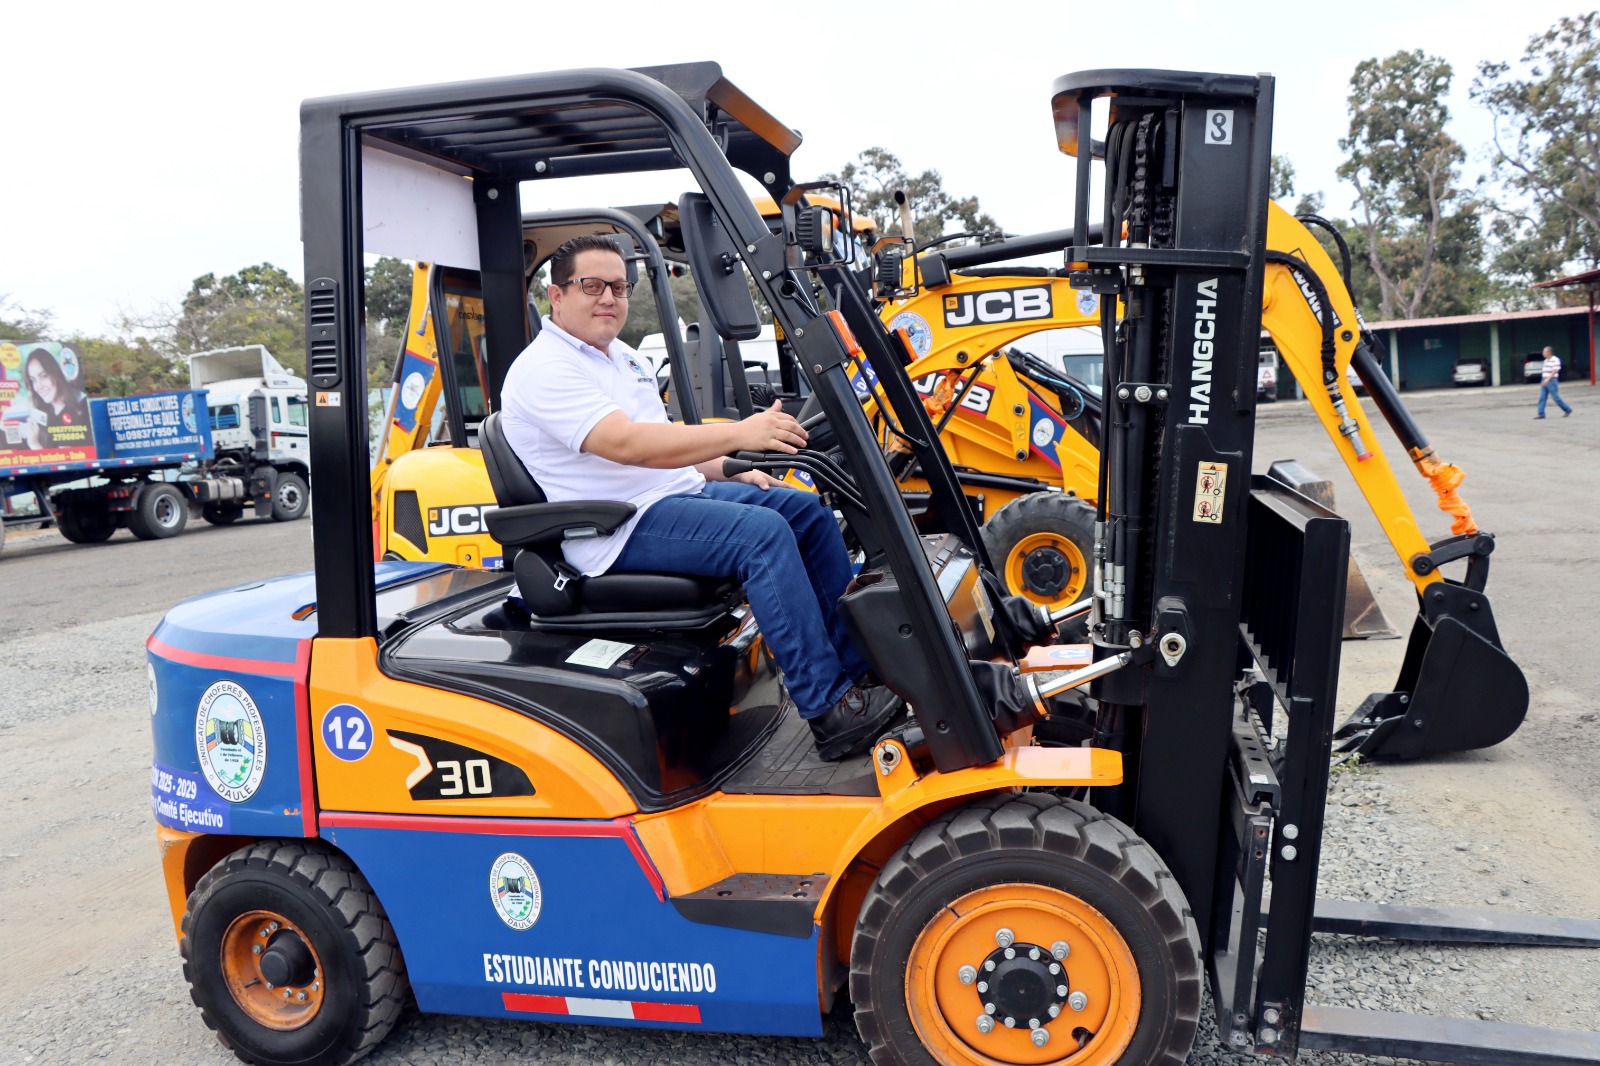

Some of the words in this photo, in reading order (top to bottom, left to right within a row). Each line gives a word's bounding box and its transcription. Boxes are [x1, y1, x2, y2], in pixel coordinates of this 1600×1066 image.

[946, 288, 1051, 326] JCB
[1188, 278, 1218, 424] HANGCHA
[106, 400, 132, 417] ESCUELA
[130, 401, 140, 412] DE
[139, 395, 179, 413] CONDUCTORES
[110, 412, 154, 432] PROFESIONALES
[152, 414, 162, 425] DE
[162, 410, 180, 426] DAULE
[125, 426, 178, 440] 0983779504
[430, 505, 499, 535] JC
[204, 684, 243, 706] CHOFERES
[199, 706, 208, 718] DE
[198, 719, 209, 766] SINDICATO
[242, 696, 264, 772] PROFESIONALES
[328, 716, 366, 750] 12
[158, 770, 173, 793] 2025
[176, 777, 197, 800] 2029
[217, 783, 253, 801] DAULE
[436, 758, 492, 796] 30
[157, 795, 178, 820] Comité
[179, 802, 224, 828] Ejecutivo
[493, 869, 498, 877] DE
[495, 854, 523, 868] CHOFERES
[492, 878, 500, 908] SINDICATO
[522, 862, 540, 910] PROFESIONALES
[507, 918, 534, 929] DAULE
[483, 953, 585, 988] ESTUDIANTE
[588, 959, 717, 994] CONDUCIENDO
